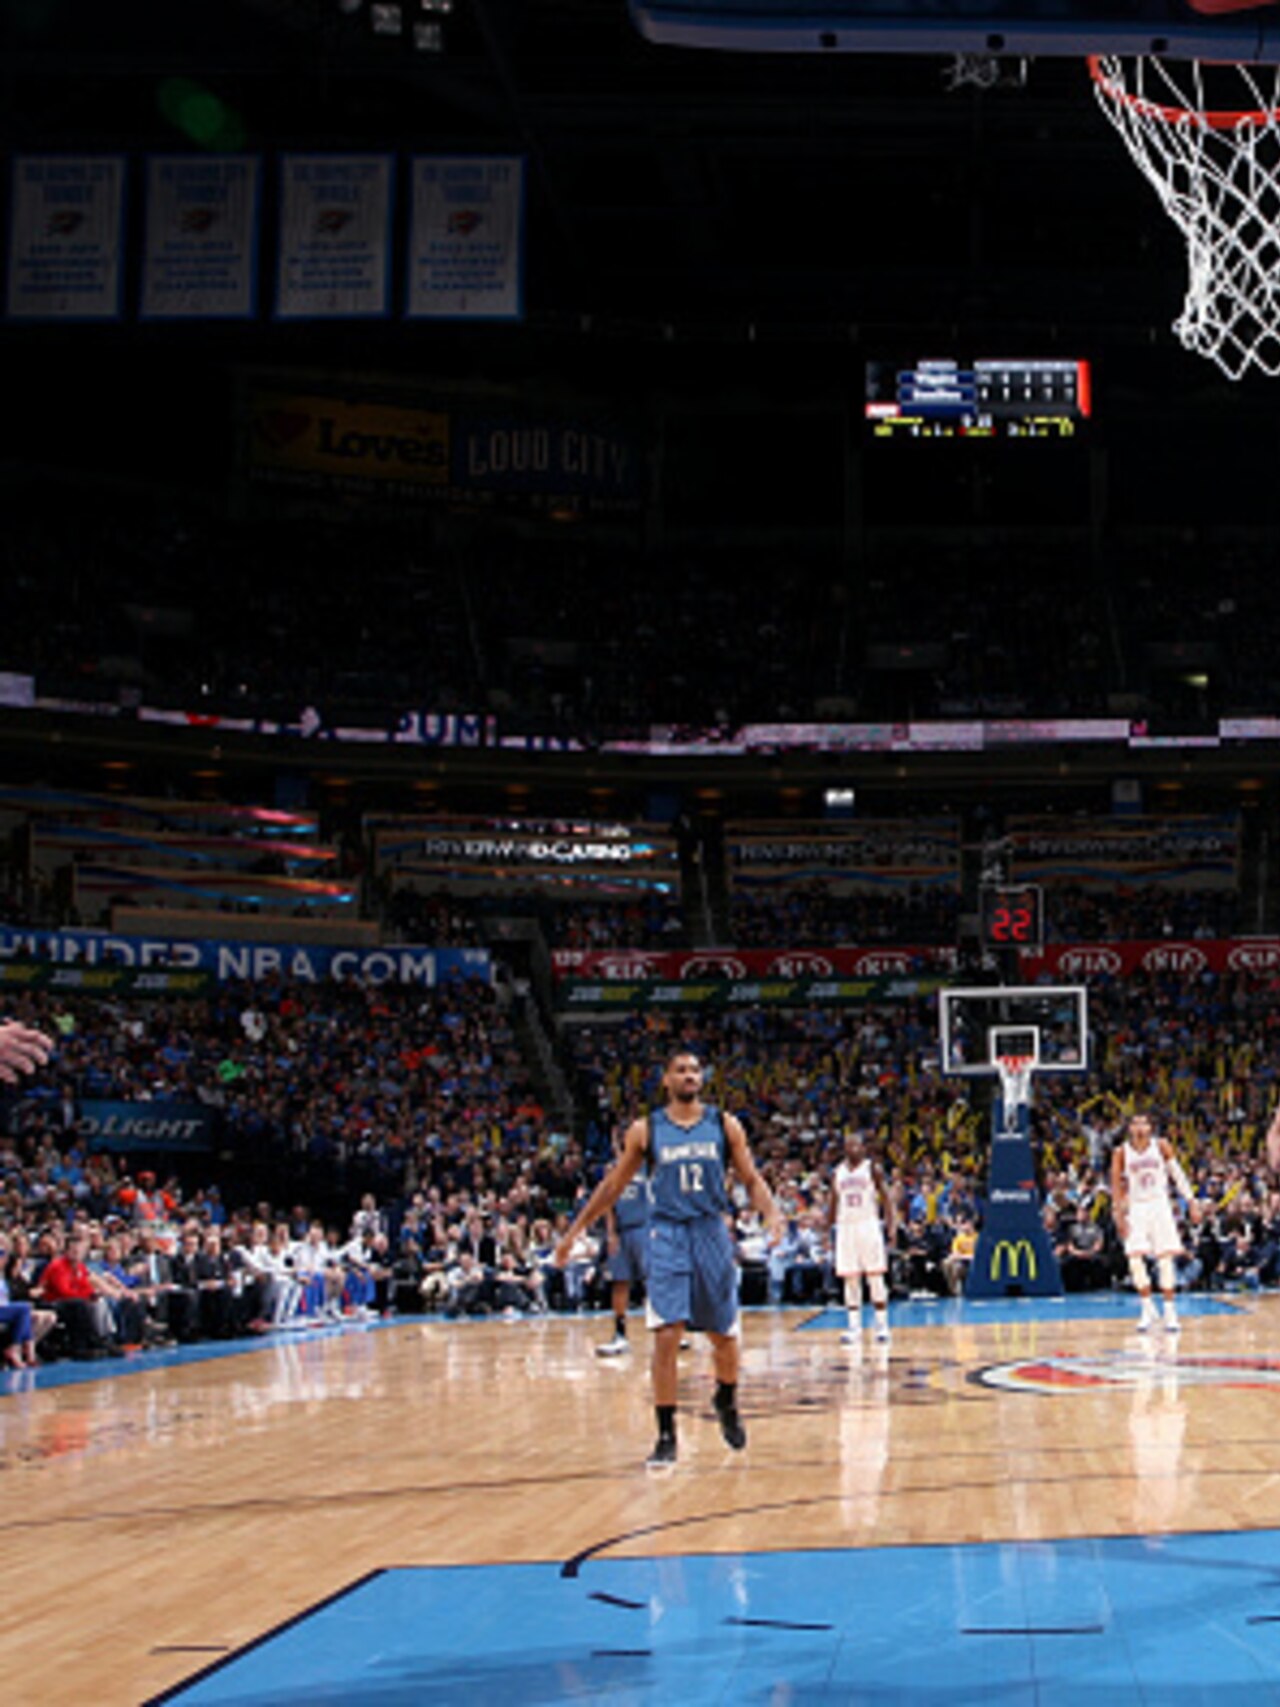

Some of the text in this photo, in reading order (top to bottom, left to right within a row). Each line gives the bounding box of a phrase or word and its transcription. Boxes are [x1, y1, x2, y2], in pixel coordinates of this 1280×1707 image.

[466, 427, 550, 478] LOUD
[991, 907, 1032, 942] 22
[101, 1113, 204, 1140] LIGHT
[678, 1163, 704, 1192] 12
